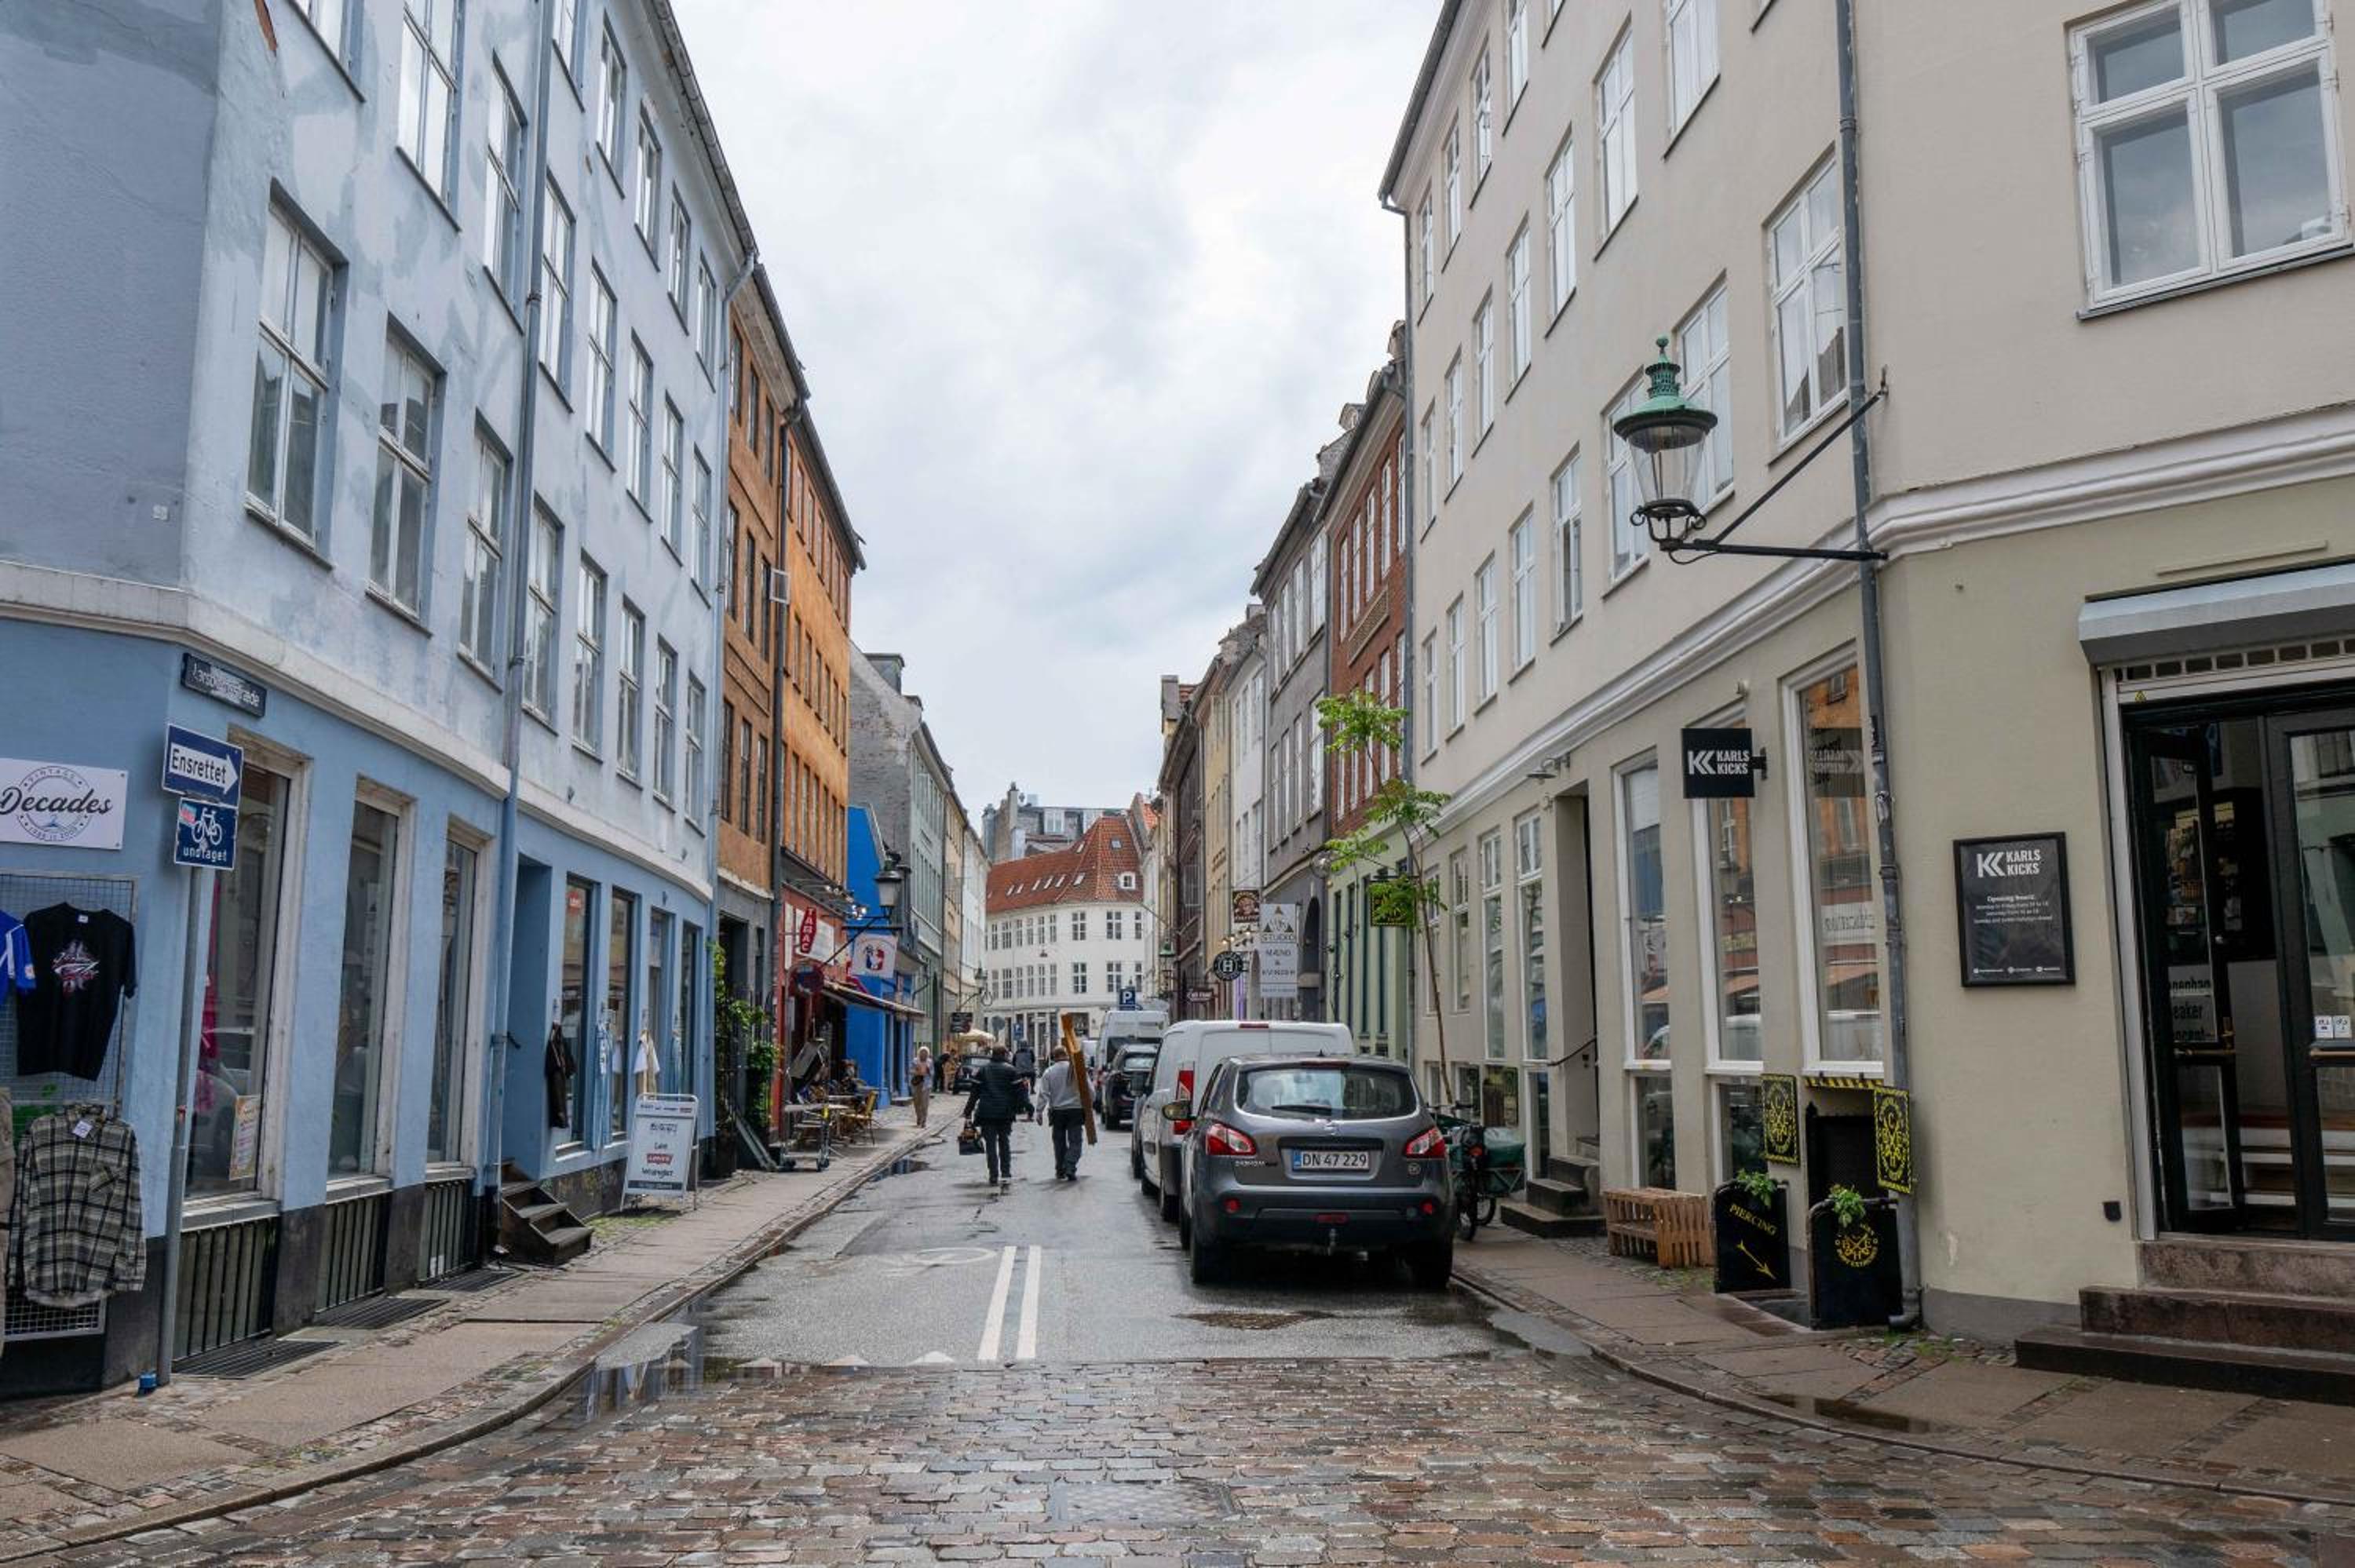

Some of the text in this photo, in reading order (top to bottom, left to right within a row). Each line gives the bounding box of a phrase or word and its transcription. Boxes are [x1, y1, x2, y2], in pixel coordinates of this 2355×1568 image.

[1717, 750, 1750, 762] KARLS
[172, 749, 227, 783] Ensrettet
[1717, 762, 1748, 775] KICKS
[0, 786, 113, 815] Decades
[2006, 849, 2041, 862] KARLS
[2007, 862, 2041, 876] KICKS
[801, 908, 815, 951] TABAC
[1123, 990, 1133, 1004] P
[1302, 1153, 1367, 1167] DN 47 229
[1729, 1203, 1778, 1235] PIERCING
